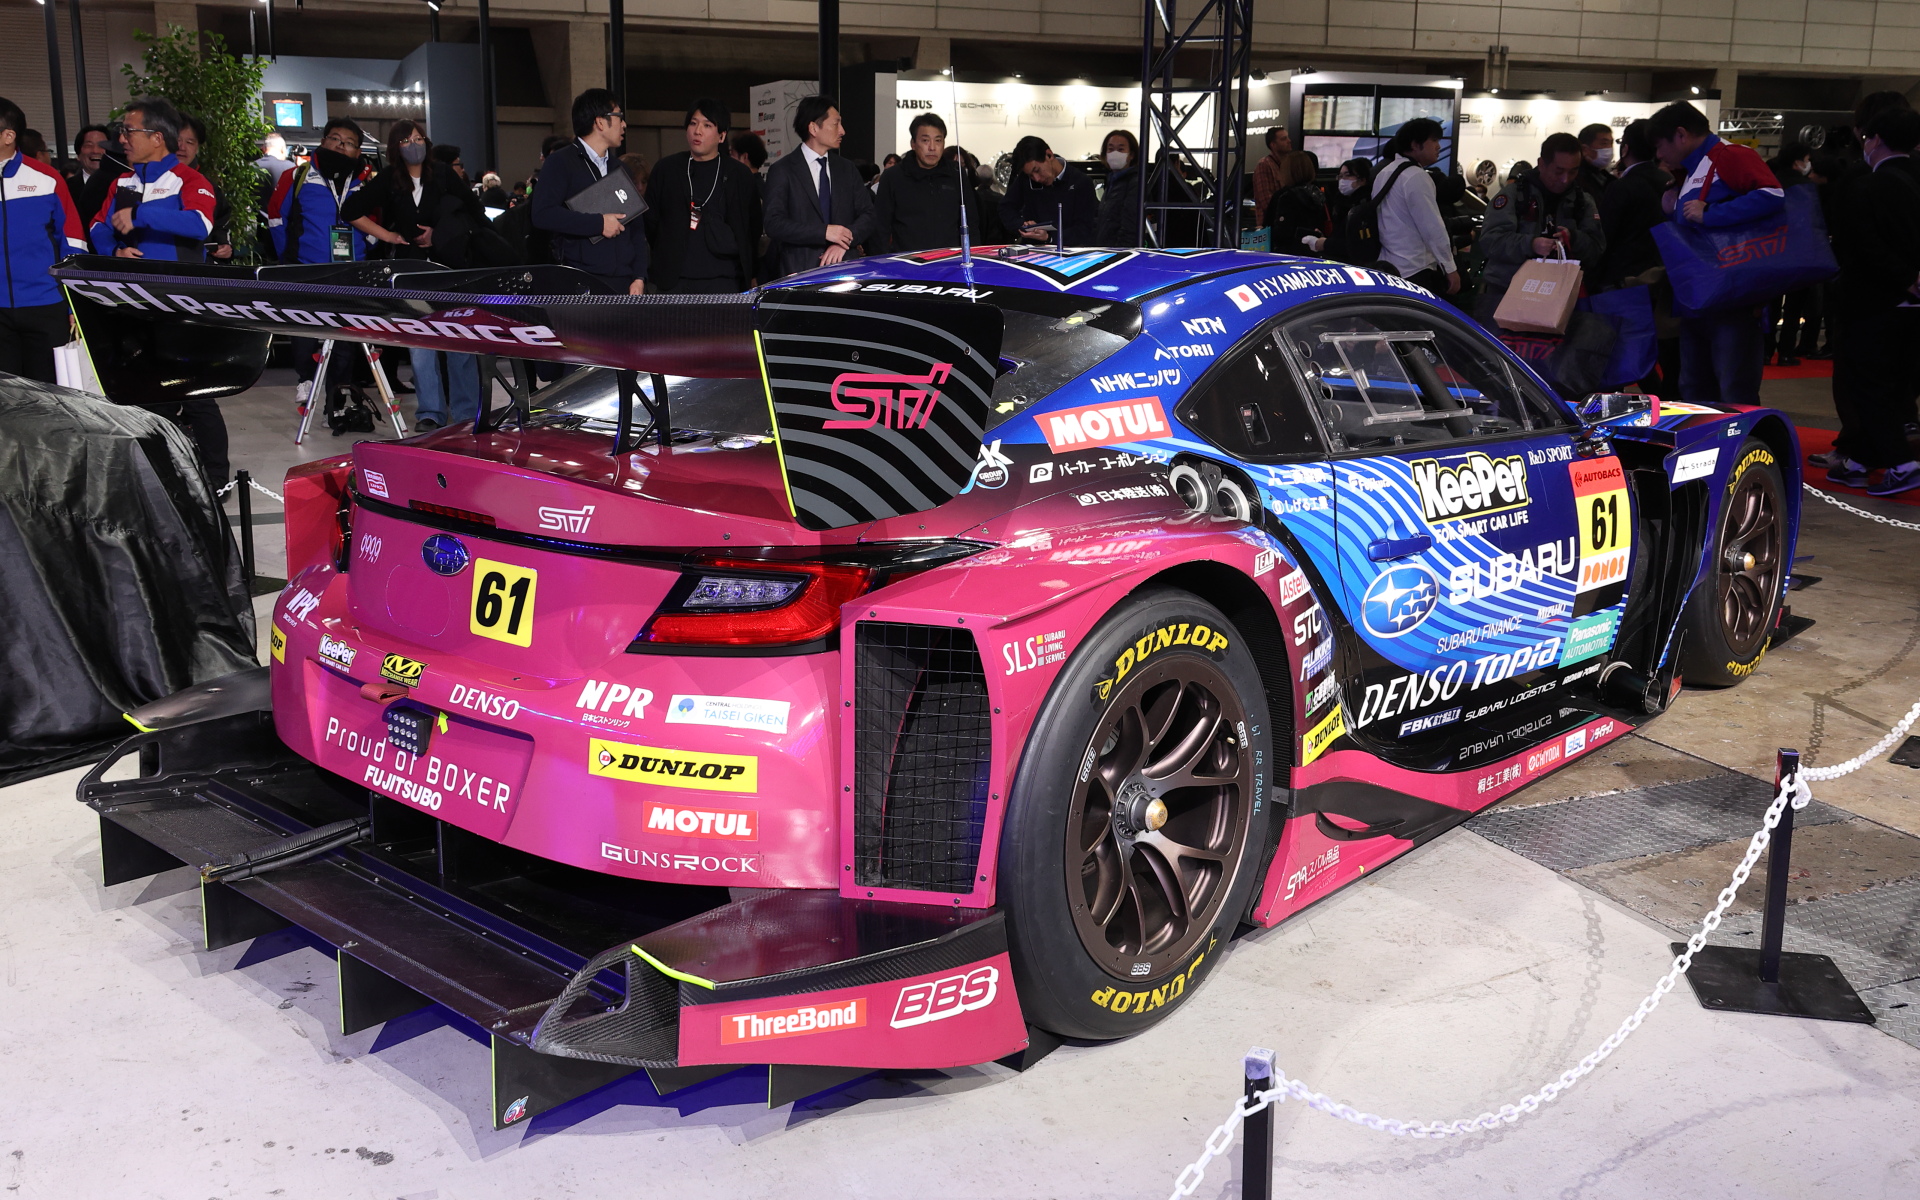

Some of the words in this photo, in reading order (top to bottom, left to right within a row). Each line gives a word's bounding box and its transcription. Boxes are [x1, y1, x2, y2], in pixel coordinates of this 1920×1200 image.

[1030, 103, 1065, 112] MANSORY
[1100, 101, 1129, 111] BC
[1248, 108, 1280, 122] group
[861, 283, 993, 300] SUBARU
[1253, 268, 1346, 299] H.YAMAUCHI
[62, 279, 174, 313] STI
[167, 293, 567, 347] Performance
[1181, 316, 1226, 336] NTN
[1090, 368, 1180, 393] NHKニッパツ
[1050, 402, 1164, 448] MOTUL
[1059, 459, 1096, 476] パーカー
[1528, 449, 1546, 466] R&D
[1547, 446, 1573, 463] SPORT
[1690, 458, 1716, 470] Strada
[1734, 448, 1774, 483] DUNLOP
[979, 469, 1003, 480] GROUP
[1412, 455, 1527, 519] KeePer
[1583, 467, 1621, 483] AUTOBACS
[1435, 526, 1456, 544] FOR
[1457, 519, 1488, 538] SMART
[1489, 514, 1508, 532] CAR
[1509, 510, 1529, 527] LIFE
[1592, 494, 1618, 550] 61
[1449, 536, 1576, 606] SUBARU
[1582, 554, 1625, 587] PONOS
[285, 587, 320, 623] NPR
[475, 571, 531, 636] 61
[1536, 602, 1566, 620] MIZUHO
[1044, 629, 1066, 643] SUBARU
[1293, 603, 1322, 647] STC
[1436, 629, 1481, 655] SUBARU
[1481, 613, 1523, 641] FINANCE
[1569, 617, 1612, 644] Panasonic
[320, 634, 354, 665] KeePer
[1002, 636, 1037, 676] SLS
[1045, 641, 1063, 654] LIVING
[1045, 650, 1066, 664] SERVICE
[1115, 623, 1229, 685] DUNLOP
[1564, 636, 1609, 660] AUTOMOTIVE
[403, 677, 418, 687] WEAR
[1358, 659, 1468, 729] DENSO
[449, 684, 521, 720] DENSO
[575, 679, 653, 719] NPR
[705, 700, 731, 708] CENTRAL
[1464, 699, 1508, 722] SUBARU
[1510, 680, 1557, 706] LOGISTICS
[582, 711, 631, 728] 日本ピストンリング
[703, 709, 740, 721] TAISEI
[744, 712, 784, 726] GIKEN
[1313, 711, 1340, 750] DUNLOP
[1399, 716, 1434, 736] FBK
[325, 717, 387, 762] Proud
[426, 756, 511, 814] BOXER
[618, 753, 745, 781] DUNLOP
[1254, 750, 1263, 767] RR
[1535, 745, 1560, 768] CHIYODA
[364, 765, 442, 812] FUJITSUBO
[1253, 770, 1264, 817] TRAVEL
[648, 806, 752, 836] MOTUL
[1130, 962, 1152, 976] BBS
[890, 965, 1000, 1029] BBS
[732, 1002, 857, 1039] ThreeBond
[503, 1096, 529, 1124] 61
